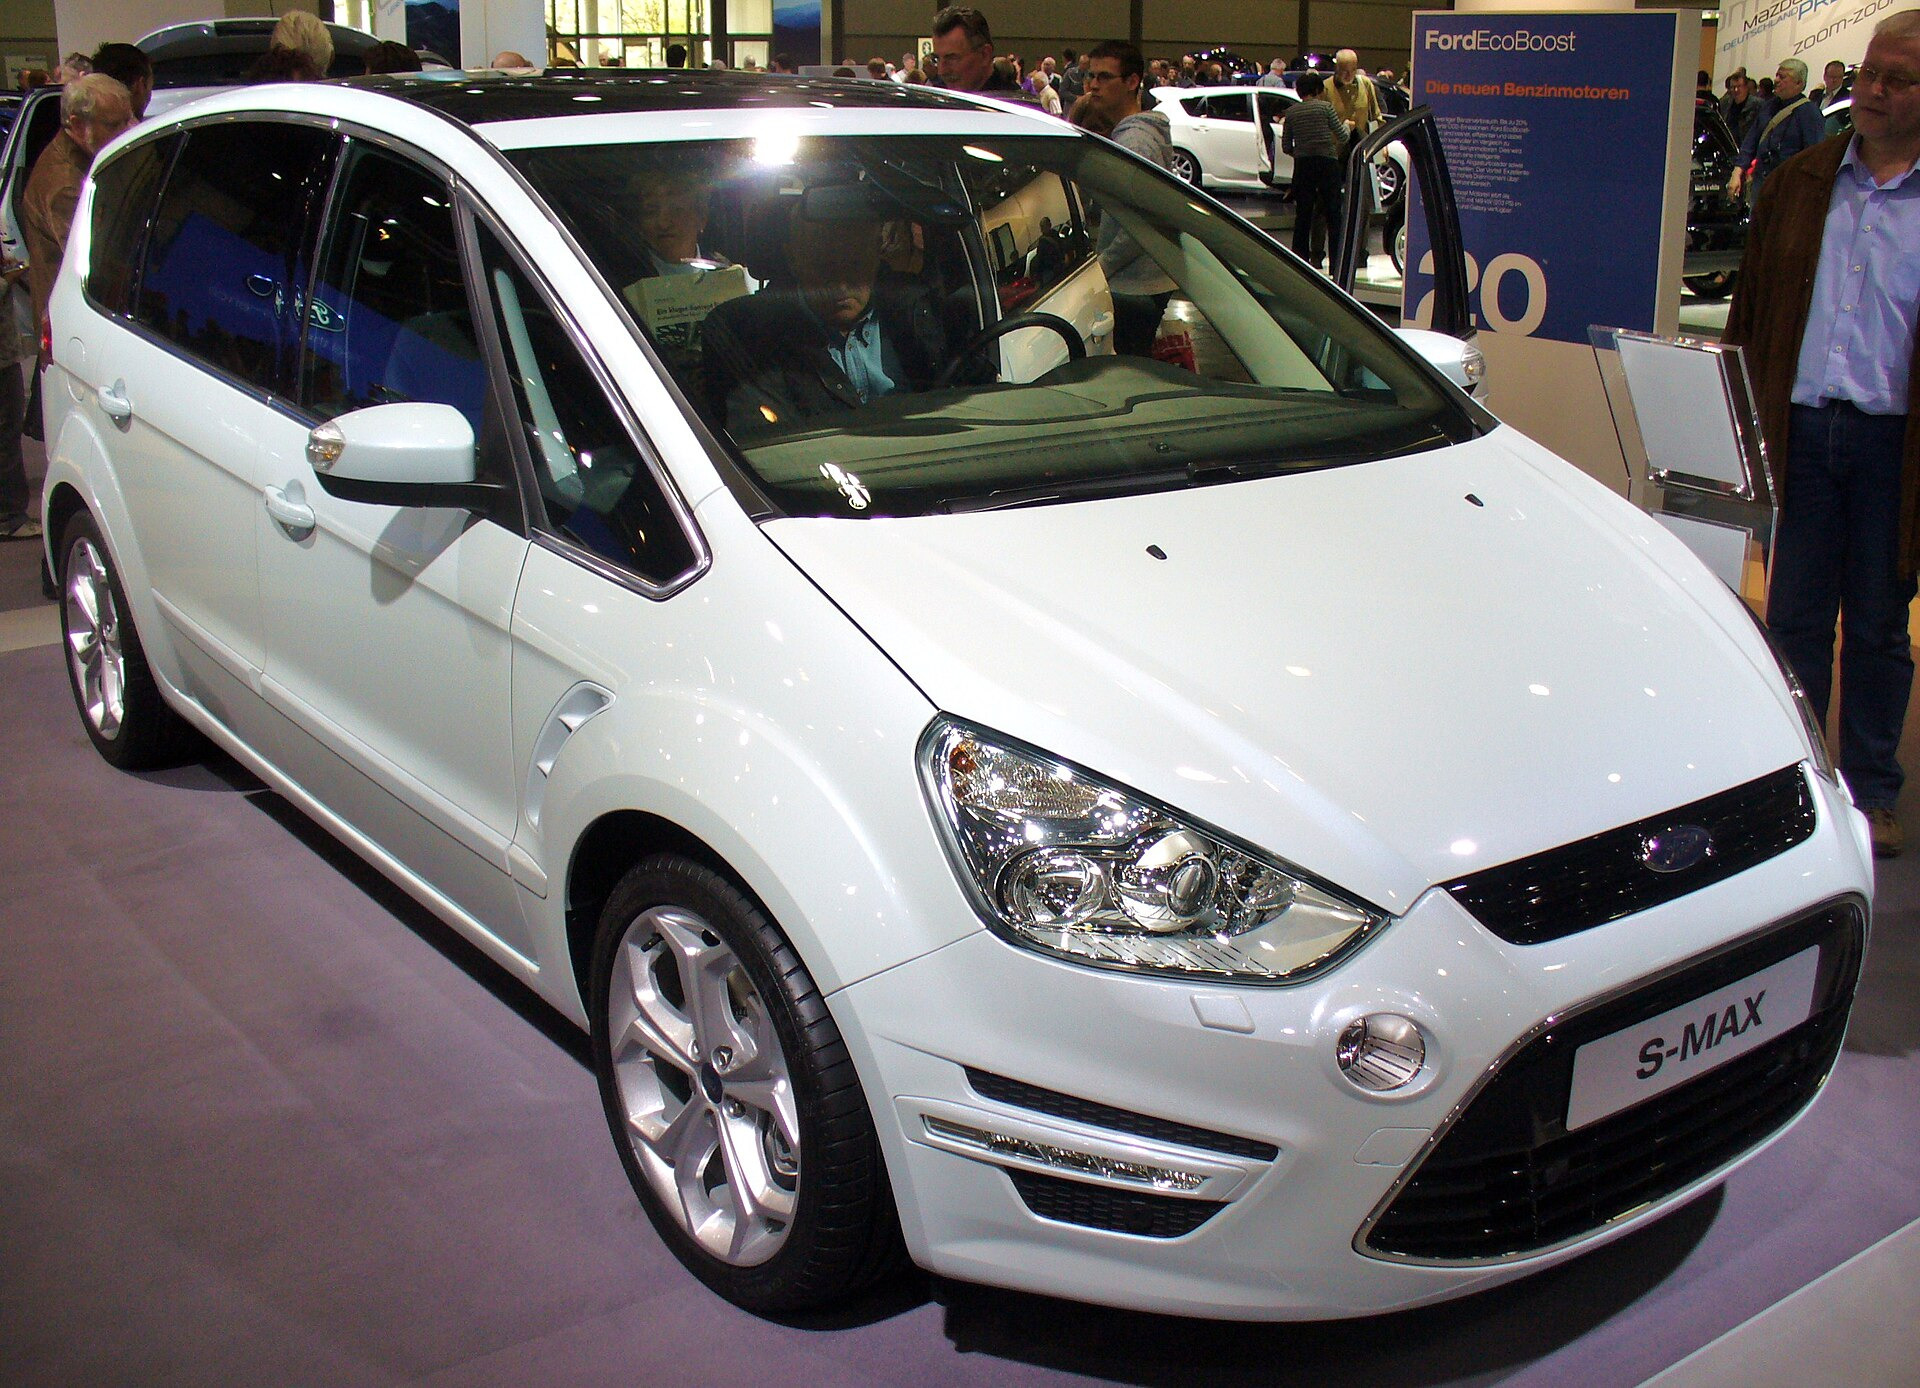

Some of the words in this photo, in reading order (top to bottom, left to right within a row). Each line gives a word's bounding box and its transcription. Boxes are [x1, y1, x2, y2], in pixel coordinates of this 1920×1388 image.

[1424, 30, 1577, 52] FordEcoBoost
[1792, 0, 1894, 56] zoom-zoo
[1425, 80, 1449, 94] Die
[1453, 83, 1500, 96] neuen
[1503, 82, 1630, 100] Benzinmotoren
[1636, 990, 1767, 1080] S-MAX
